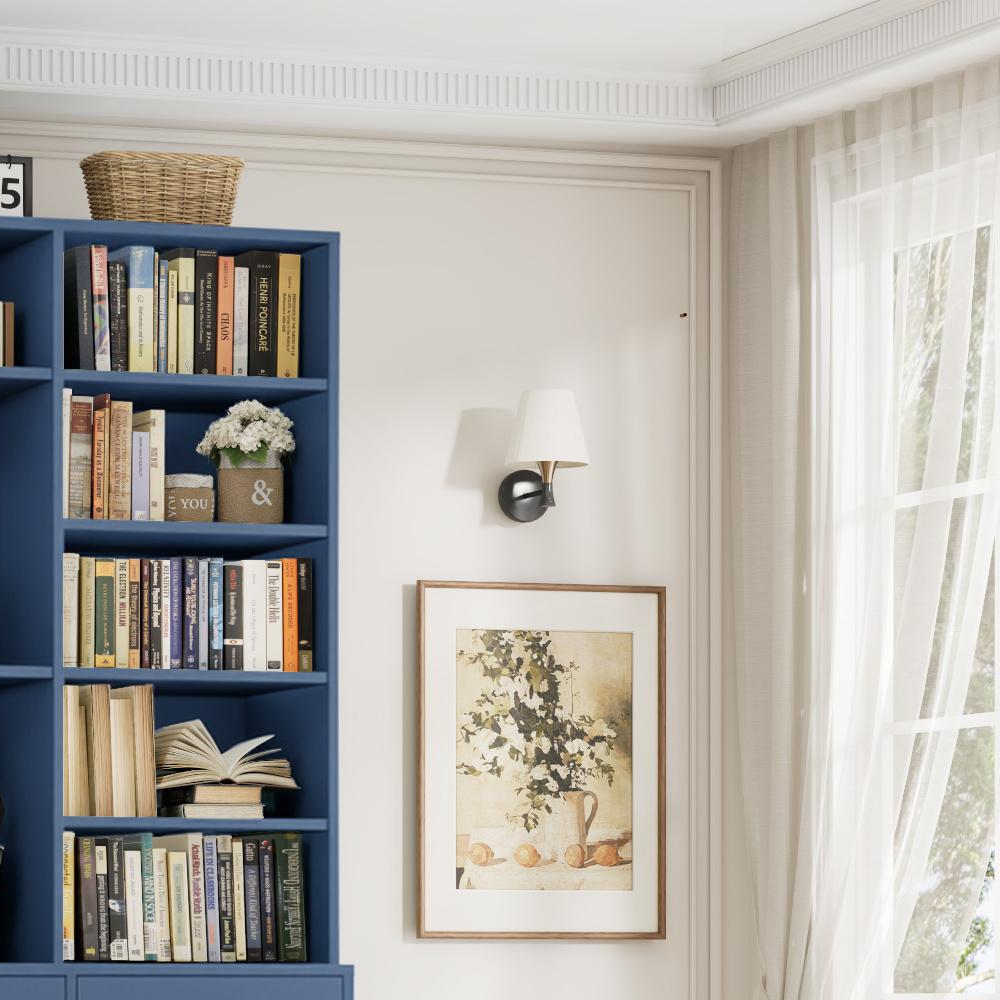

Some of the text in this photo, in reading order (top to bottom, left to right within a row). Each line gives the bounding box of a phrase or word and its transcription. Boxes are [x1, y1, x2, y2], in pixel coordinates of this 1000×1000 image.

[259, 277, 269, 351] HENRI POINCARÉ
[220, 313, 230, 341] CHAOS
[180, 498, 208, 509] YOU
[252, 480, 273, 506] &
[119, 562, 127, 571] THE
[269, 575, 280, 623] The Double Helix
[206, 858, 213, 866] IN
[246, 843, 255, 861] Gatto
[206, 867, 215, 910] CLASSROOMS
[247, 875, 257, 898] Different
[249, 899, 257, 912] Kind
[250, 920, 259, 940] Teacher
